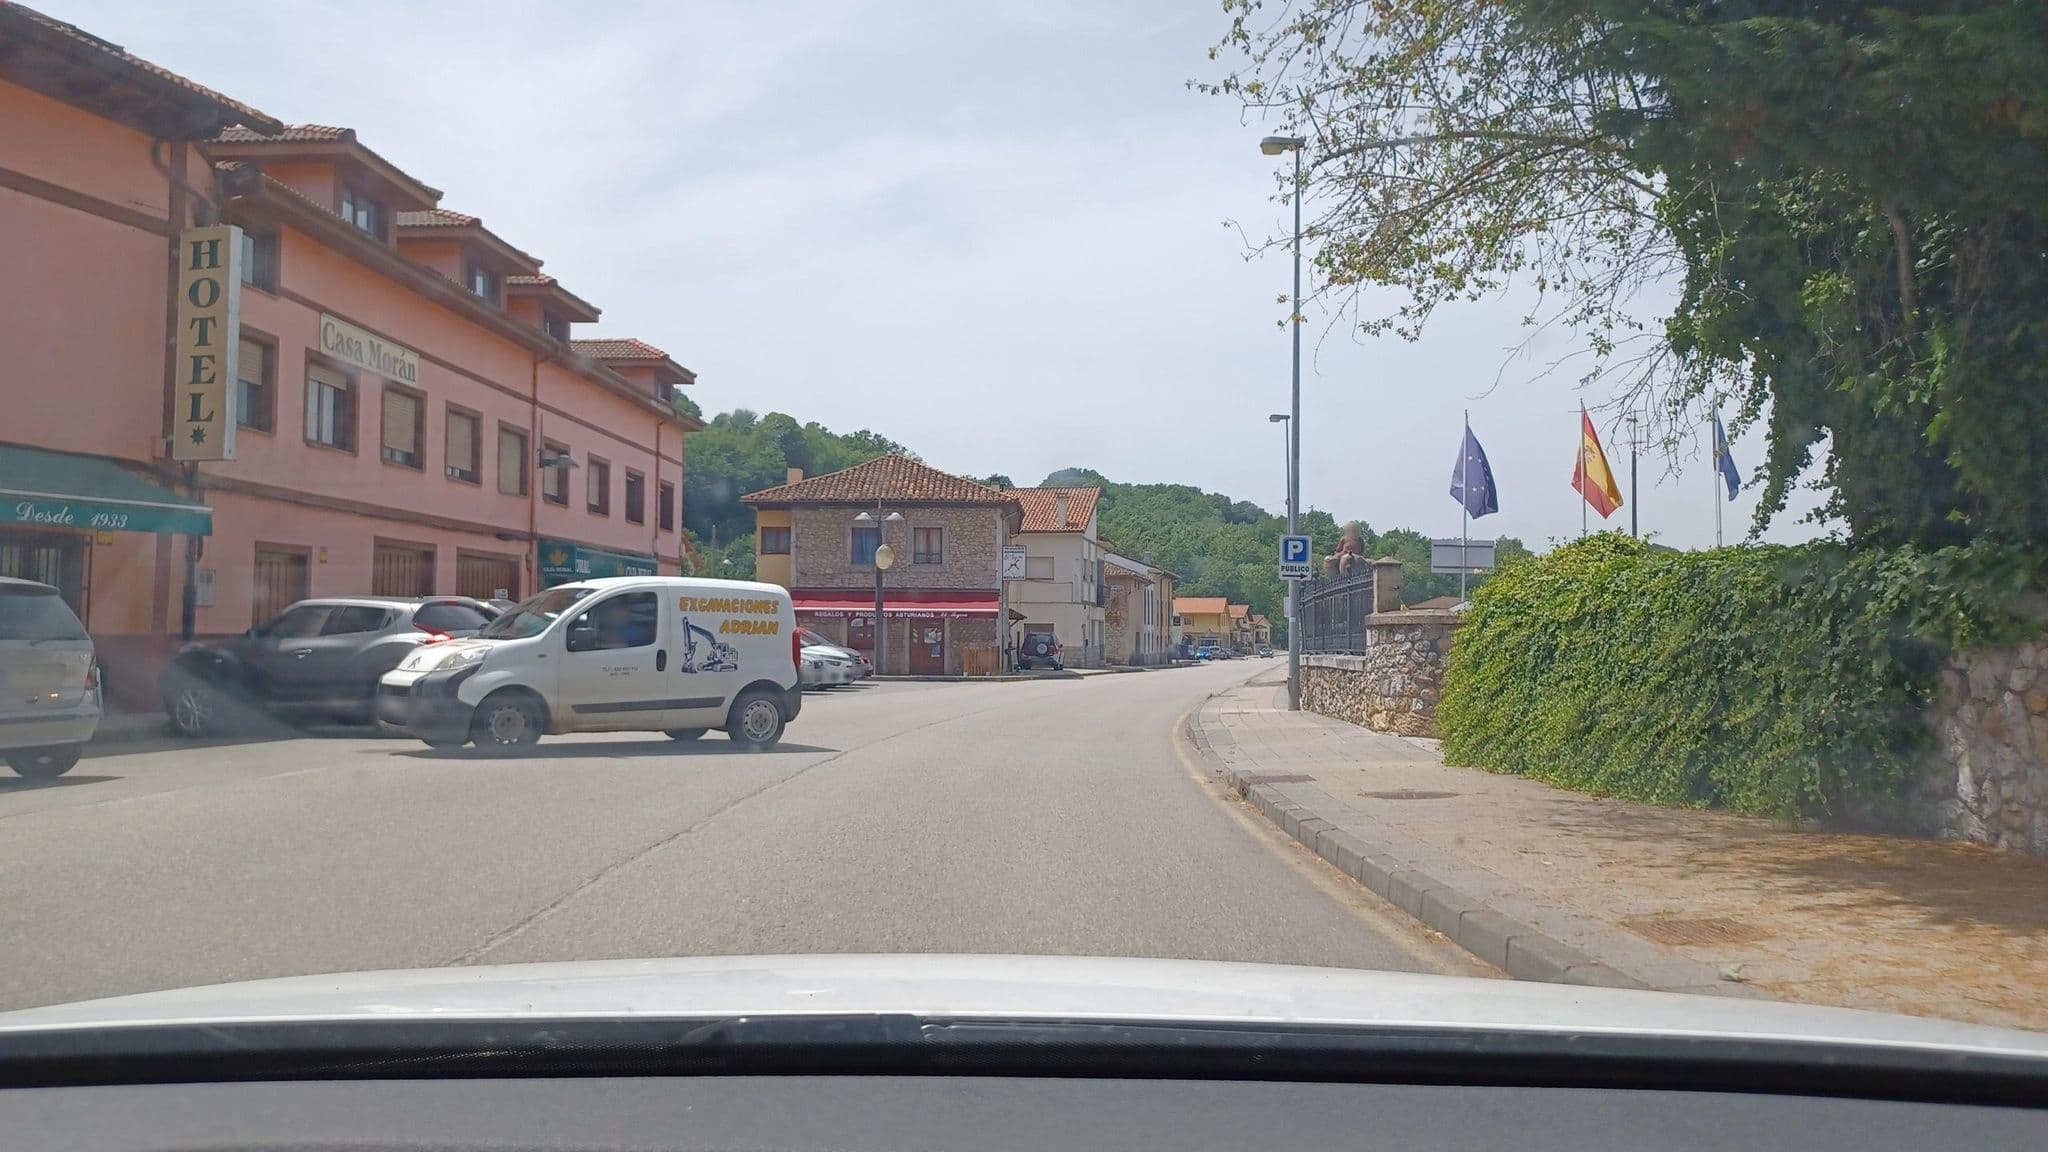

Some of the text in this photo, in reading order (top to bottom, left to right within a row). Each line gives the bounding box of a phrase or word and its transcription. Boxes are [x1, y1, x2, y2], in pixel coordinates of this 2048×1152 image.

[187, 238, 222, 423] HOTEL
[323, 321, 416, 382] Casa Morán
[16, 502, 129, 528] Desde 1933
[1287, 540, 1304, 560] P
[680, 597, 779, 614] EXCAVACIONES
[720, 619, 779, 635] ADRIAN
